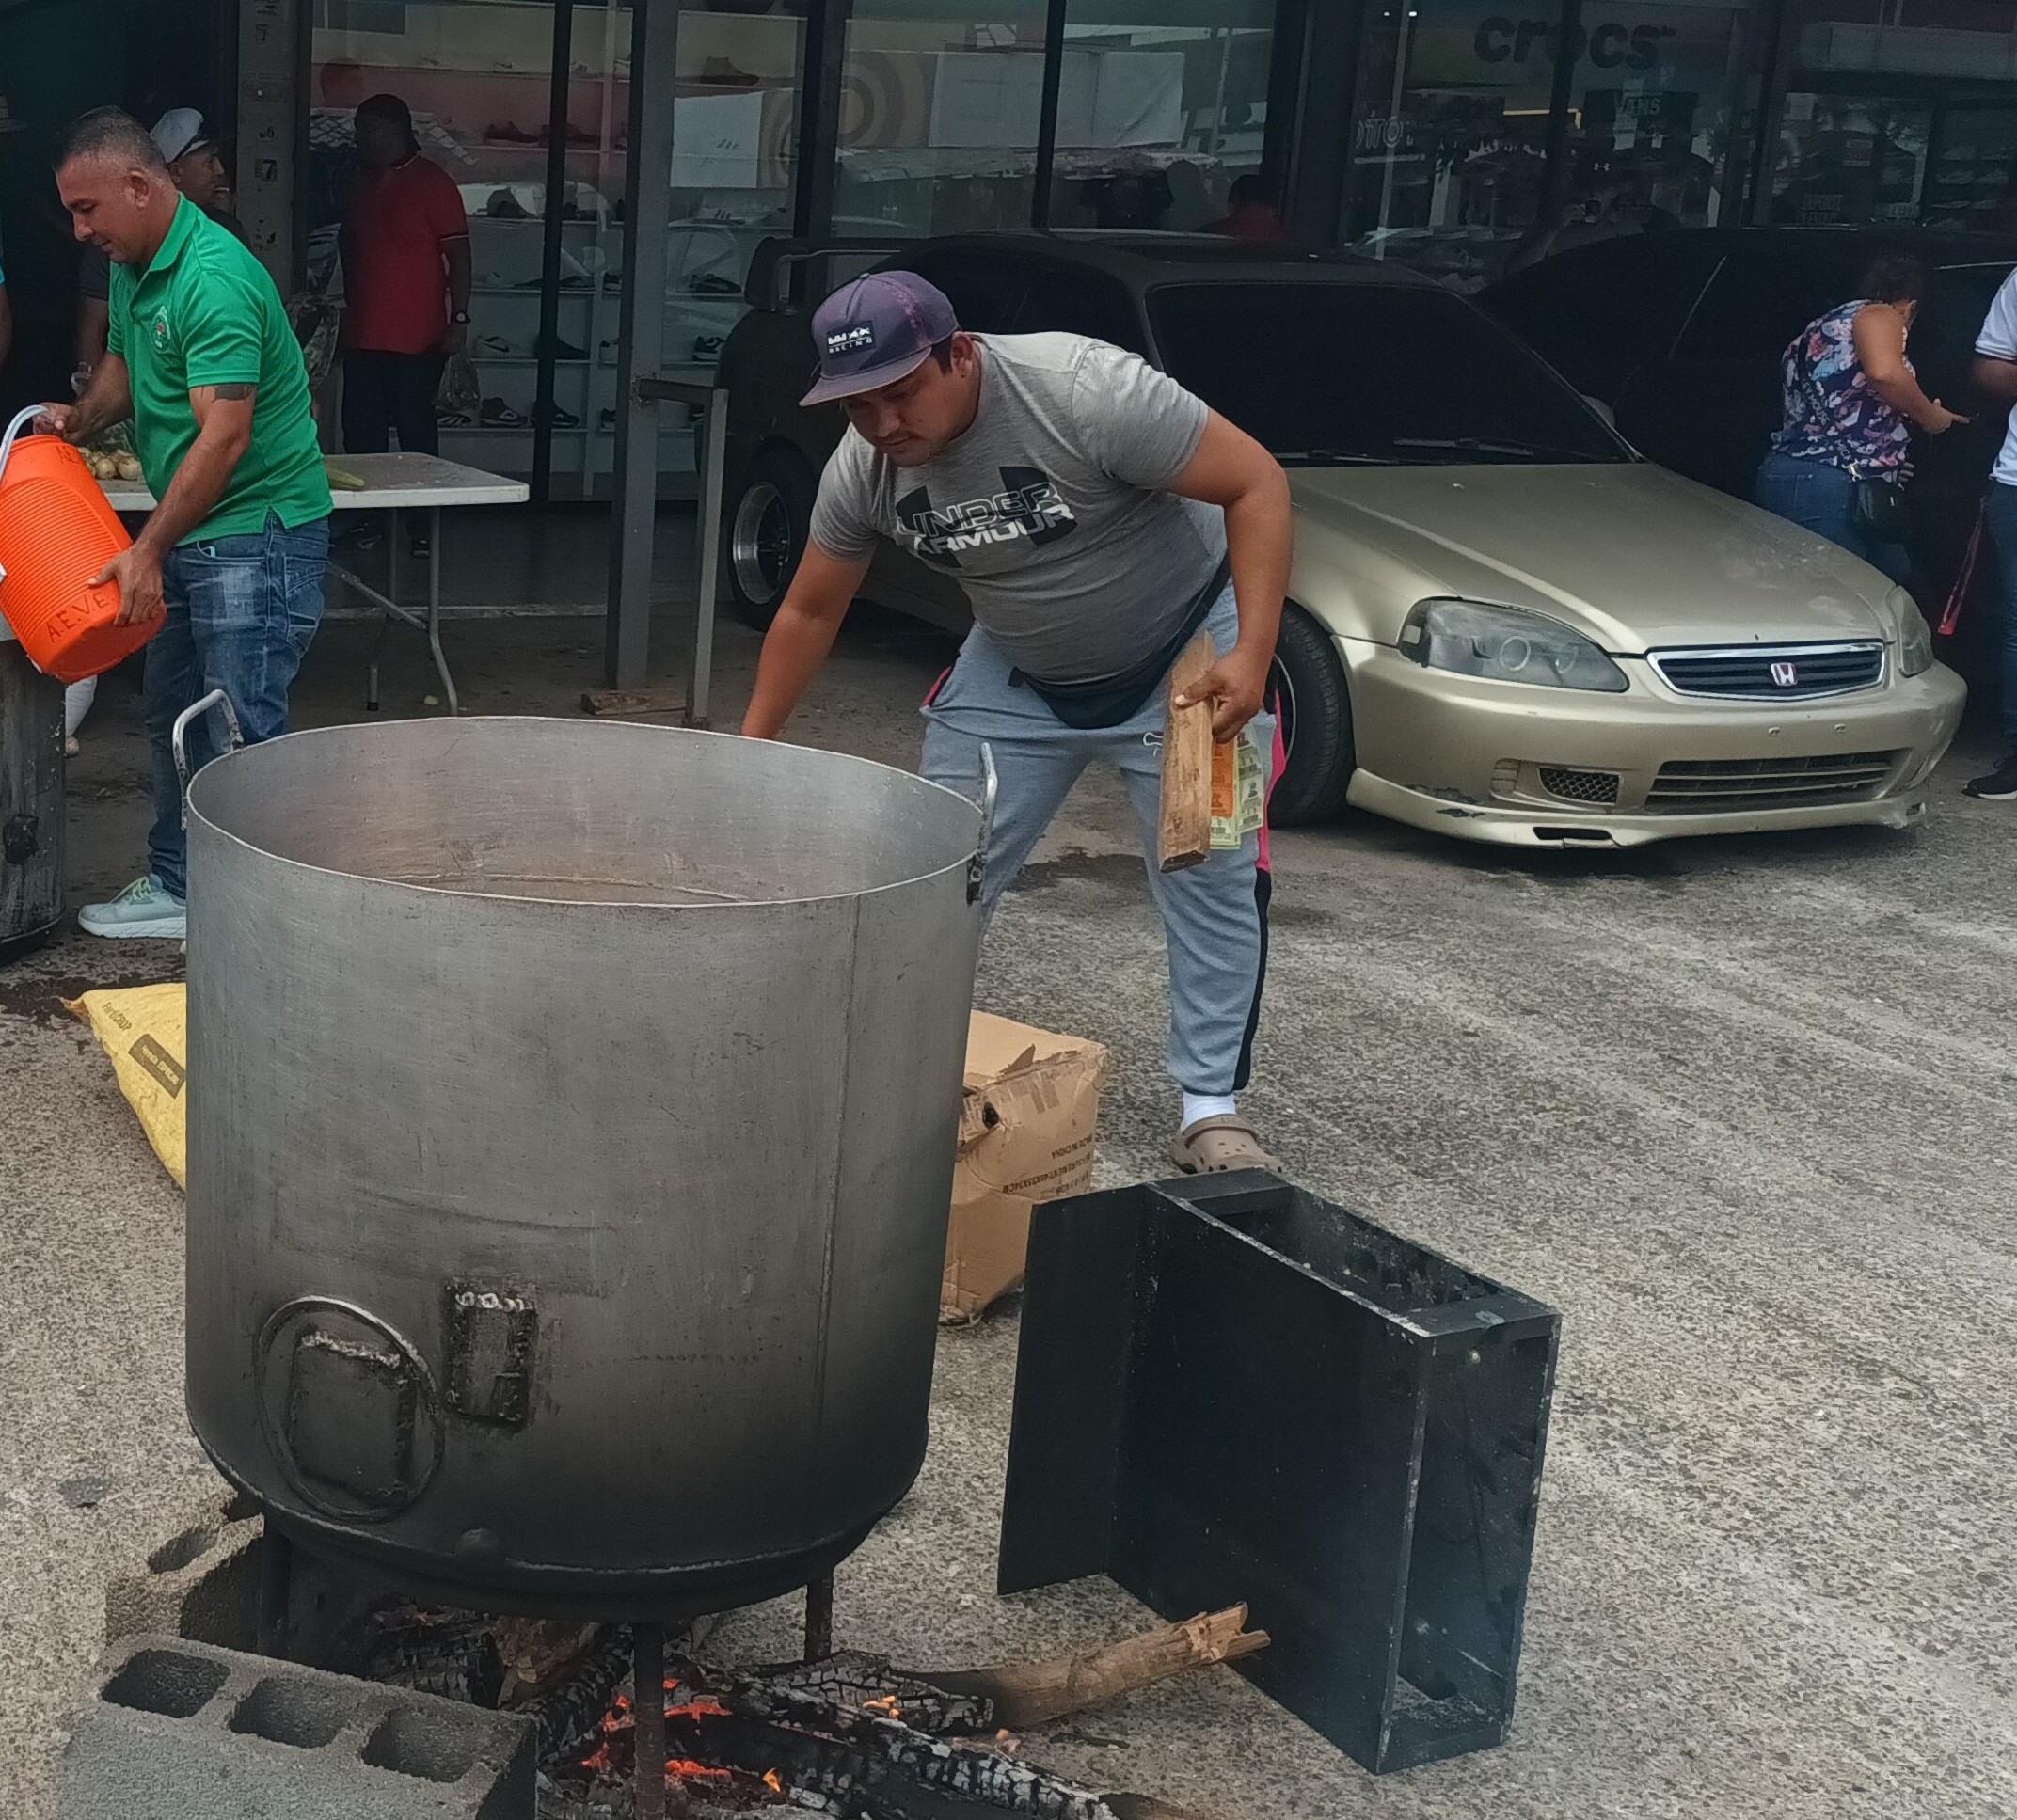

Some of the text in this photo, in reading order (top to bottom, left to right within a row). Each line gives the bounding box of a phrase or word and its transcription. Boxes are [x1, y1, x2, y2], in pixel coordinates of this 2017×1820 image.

[1474, 14, 1660, 71] crocs
[897, 482, 1063, 537] UNDER
[914, 503, 1074, 554] ARMOUR
